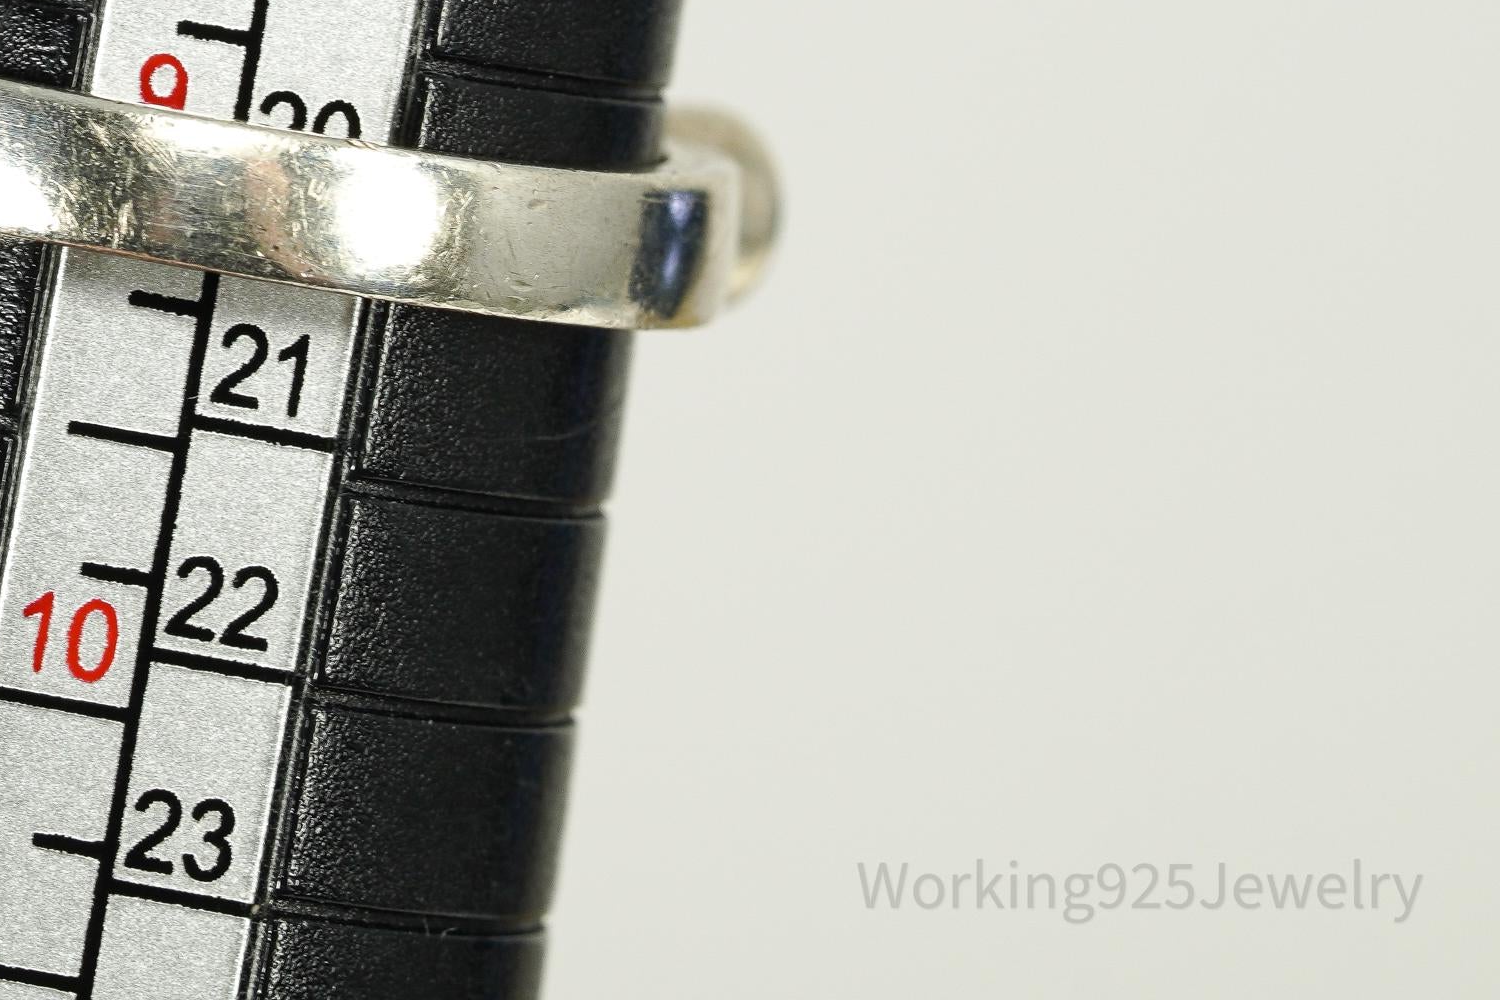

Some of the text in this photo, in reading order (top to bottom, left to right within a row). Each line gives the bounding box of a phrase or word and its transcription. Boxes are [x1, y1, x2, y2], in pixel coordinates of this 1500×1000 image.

[139, 53, 189, 111] 9
[209, 322, 311, 418] 21
[23, 591, 120, 684] 10
[163, 555, 280, 652] 22
[123, 788, 236, 883] 23
